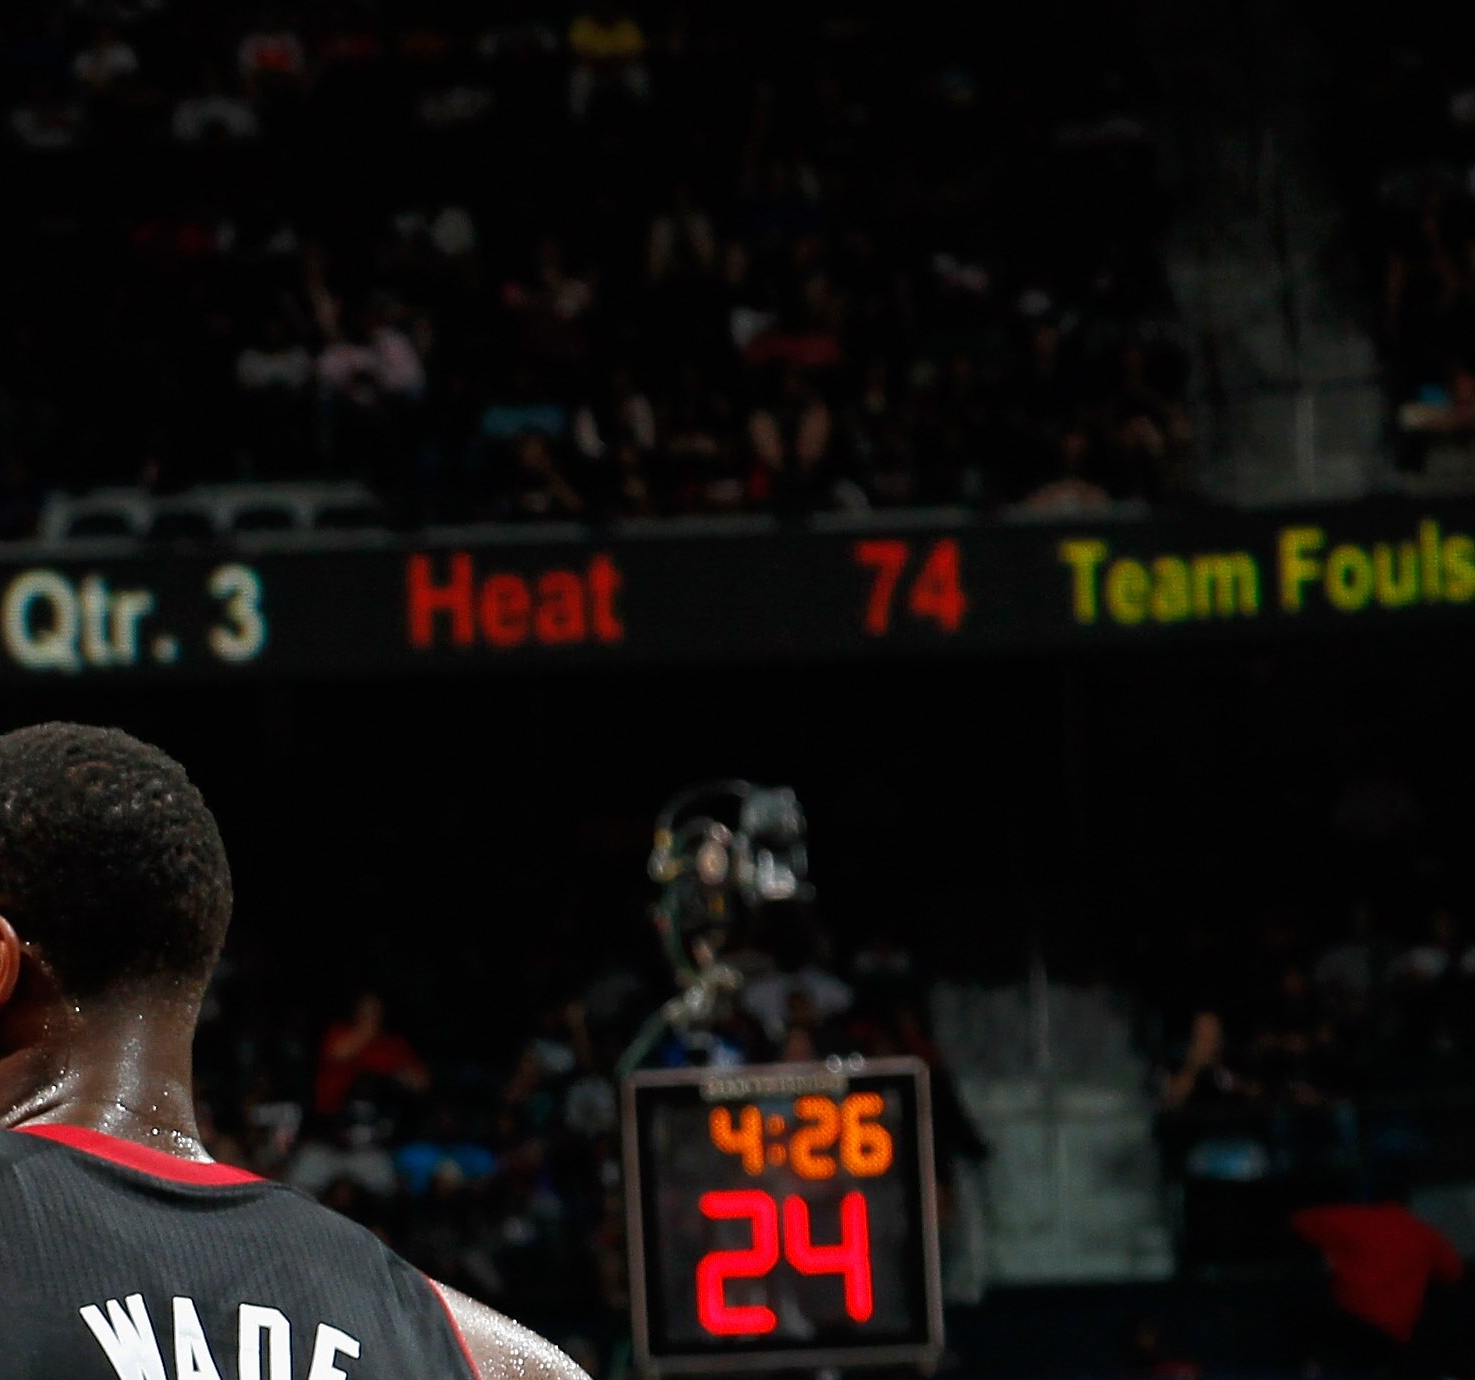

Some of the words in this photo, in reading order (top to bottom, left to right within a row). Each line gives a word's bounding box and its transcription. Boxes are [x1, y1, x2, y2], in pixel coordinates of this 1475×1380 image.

[0, 570, 178, 672] Qtr.
[211, 564, 267, 662] 3
[408, 553, 624, 650] Heat
[857, 539, 967, 635] 74
[1061, 539, 1259, 624] Team
[708, 1091, 894, 1181] 4:26
[695, 1188, 875, 1337] 24
